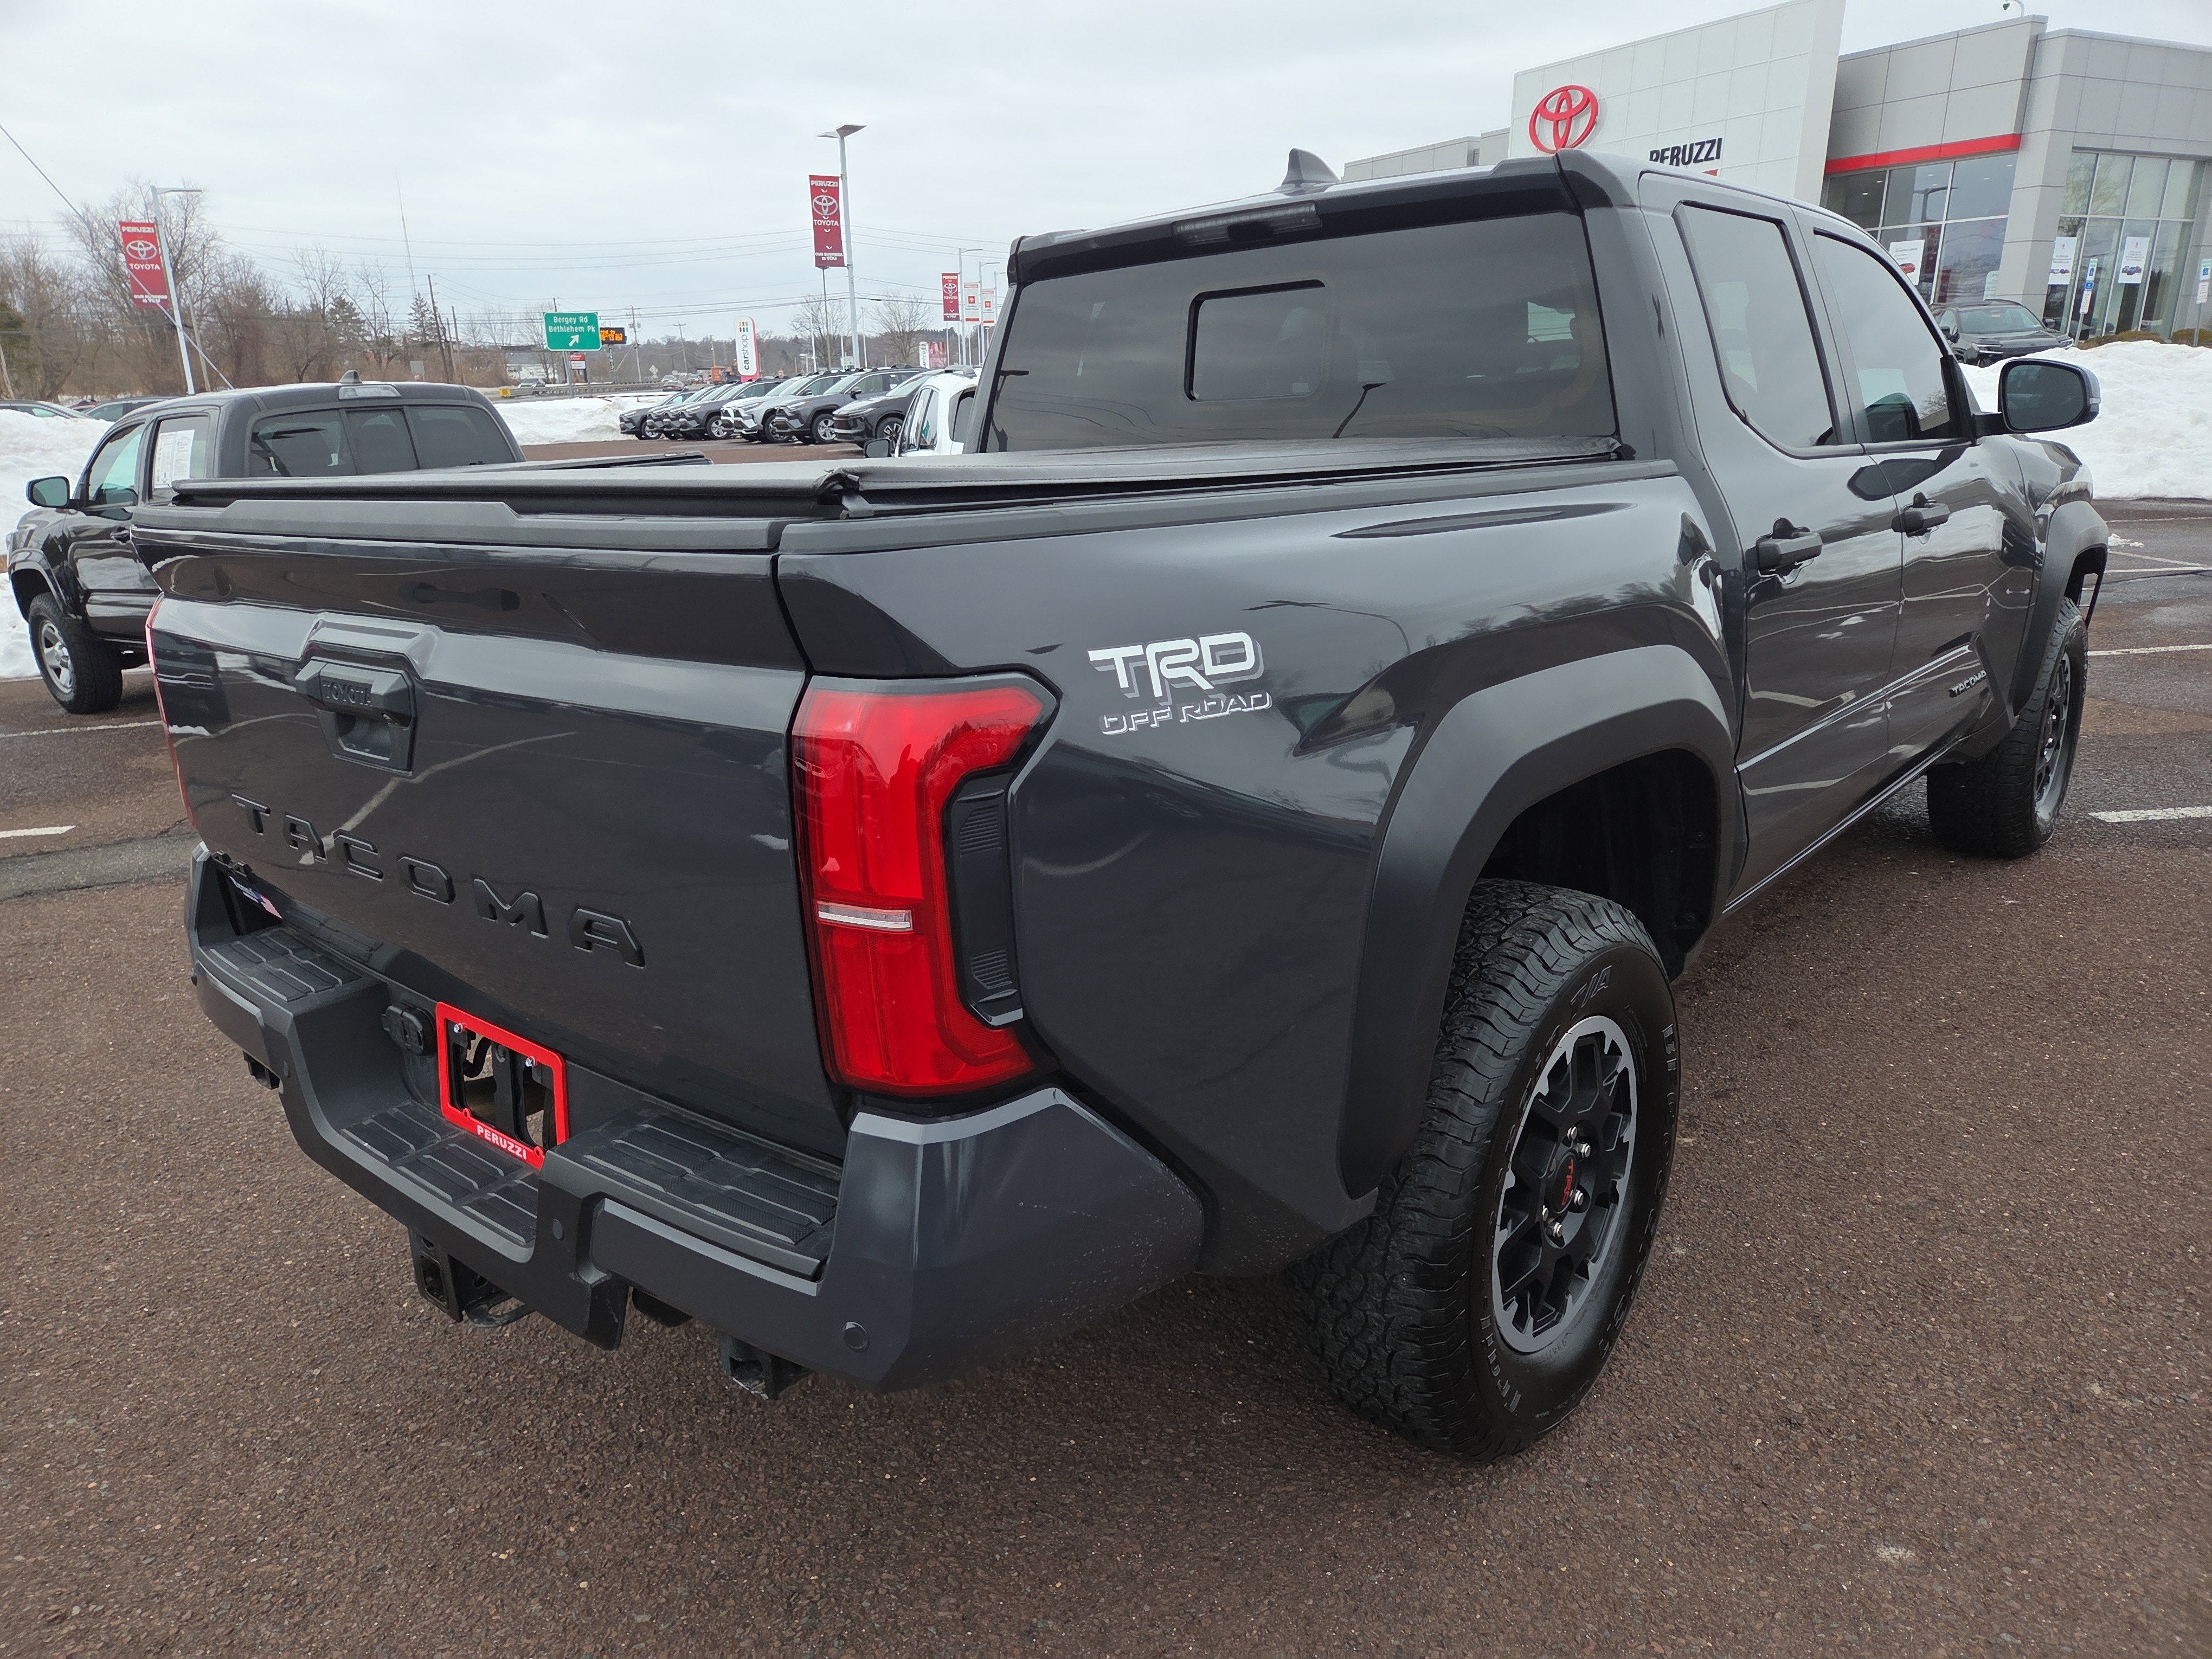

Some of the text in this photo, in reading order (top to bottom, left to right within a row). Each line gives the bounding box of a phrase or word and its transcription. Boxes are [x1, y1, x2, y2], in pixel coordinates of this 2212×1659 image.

[553, 316, 577, 324] Bergey
[741, 334, 750, 370] carshop
[1088, 631, 1264, 706] TRD
[1950, 670, 1987, 696] TACOMA
[1099, 692, 1272, 736] OFF ROAD
[231, 793, 647, 969] TACOMA
[476, 1124, 527, 1160] PERUZZI
[1561, 1159, 1573, 1206] TRD
